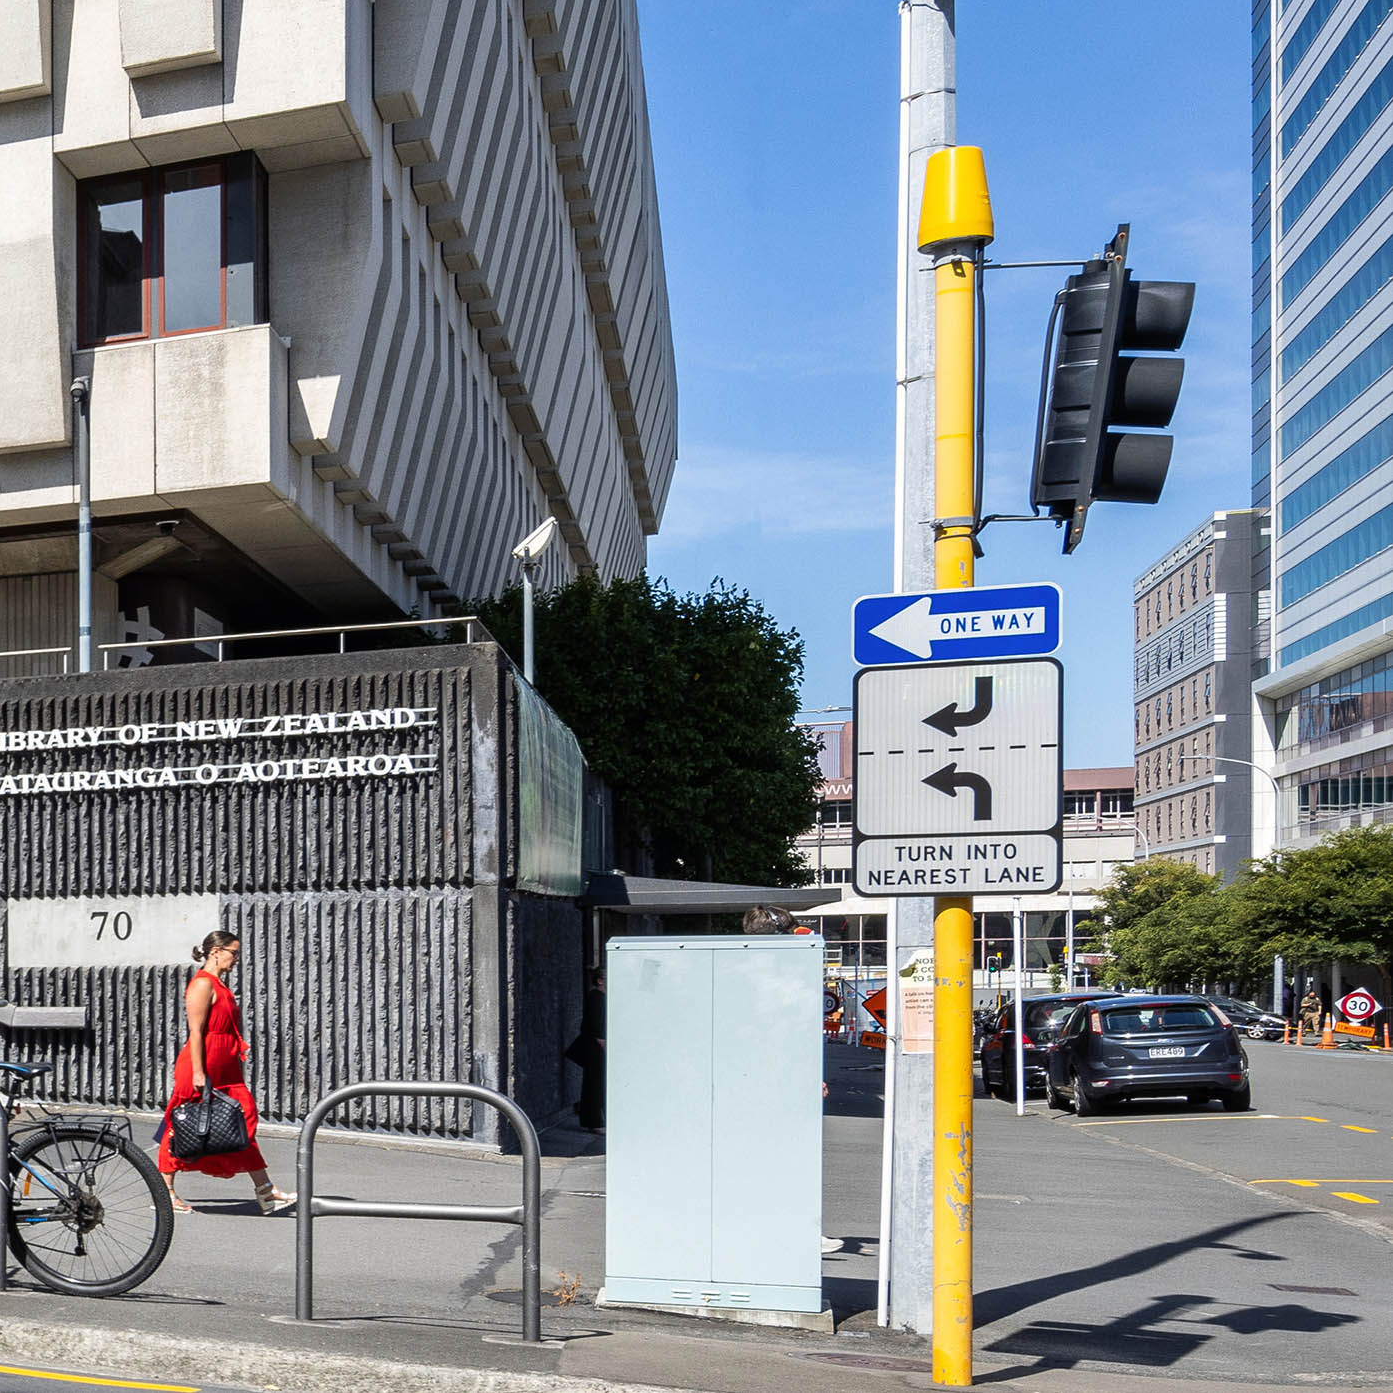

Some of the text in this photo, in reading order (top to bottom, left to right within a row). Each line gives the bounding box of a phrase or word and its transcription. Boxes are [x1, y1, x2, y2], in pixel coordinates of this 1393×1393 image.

[940, 612, 1035, 635] ONE WAY
[119, 723, 159, 745] OF
[176, 717, 244, 742] NEW
[263, 707, 416, 736] ZEALAND
[195, 764, 219, 785] O
[236, 753, 416, 784] AOTEAROA
[895, 843, 1017, 862] TURN INTO
[868, 866, 1044, 886] NEAREST LANE
[90, 911, 133, 942] 70
[1348, 1000, 1368, 1012] 30
